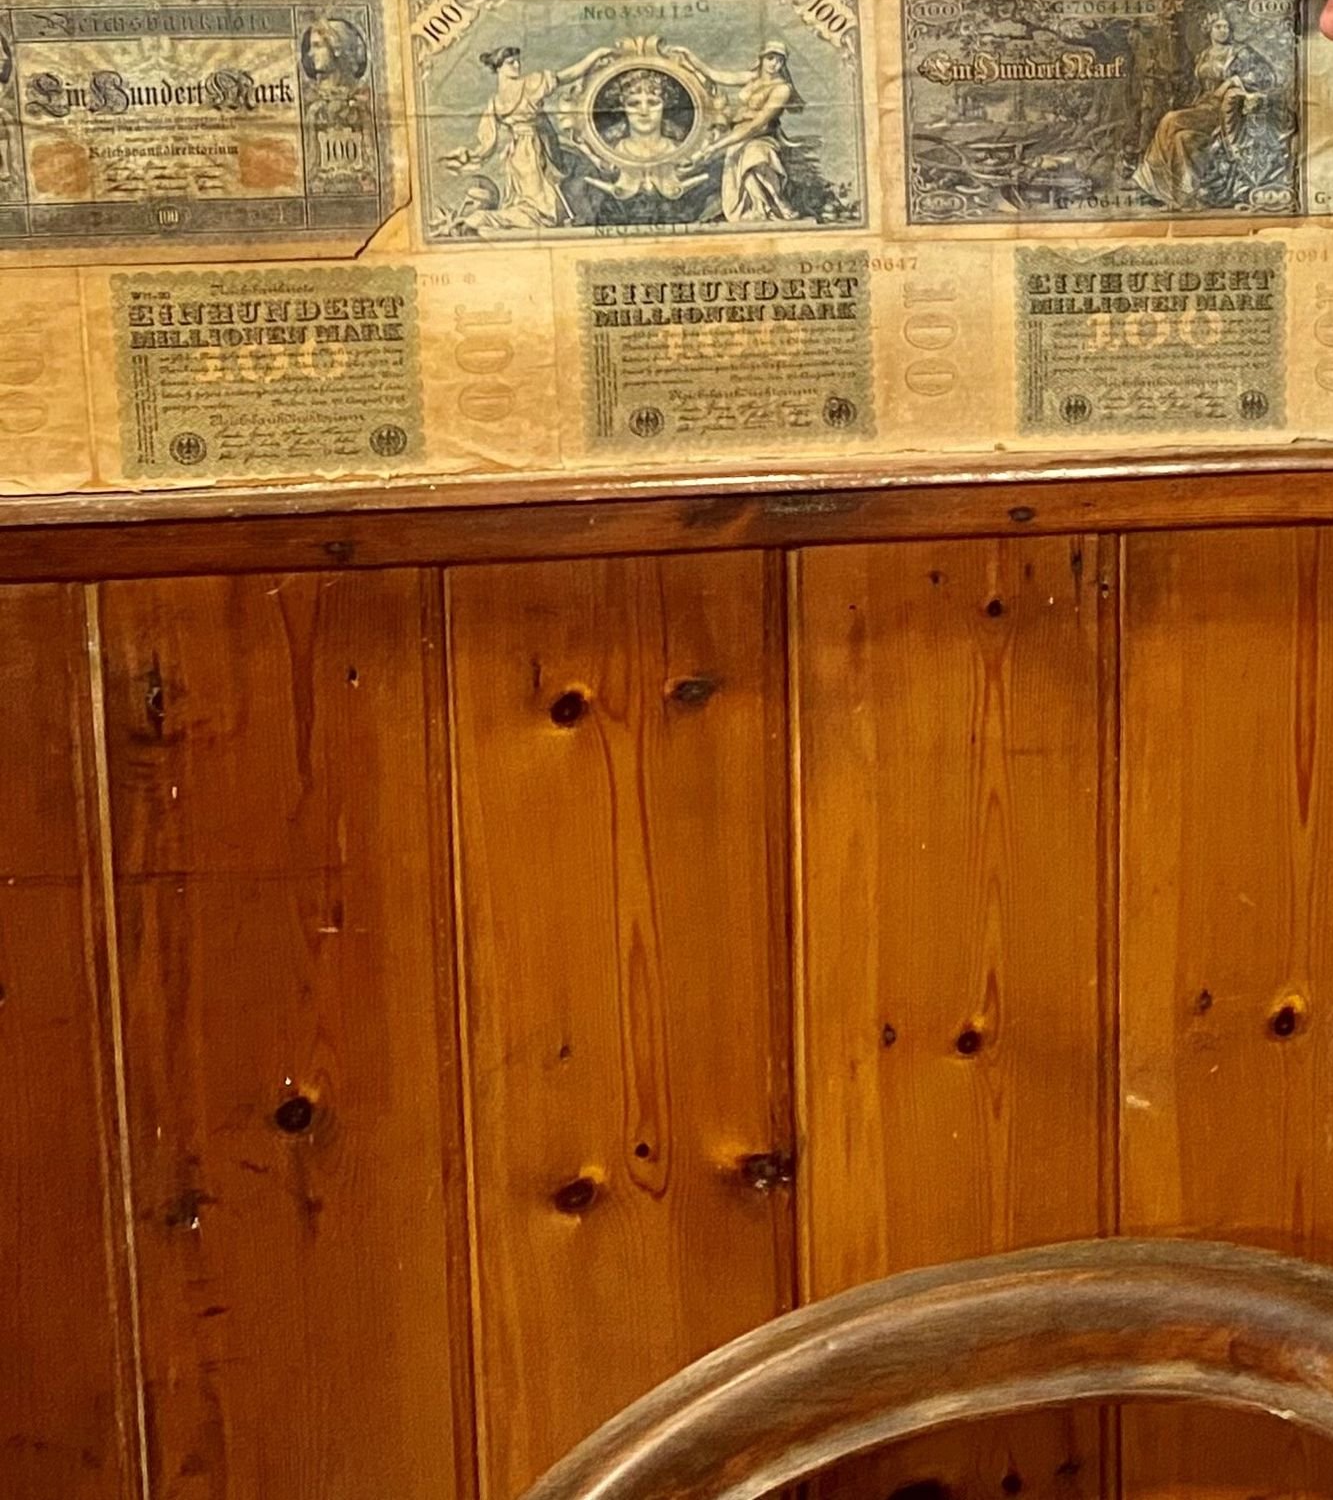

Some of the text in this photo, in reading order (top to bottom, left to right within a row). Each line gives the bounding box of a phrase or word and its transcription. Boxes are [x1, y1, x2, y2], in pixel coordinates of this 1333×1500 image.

[421, 0, 463, 43] 100
[974, 53, 1061, 83] Hundert
[90, 71, 202, 114] Hundert
[205, 69, 293, 112] Mark
[324, 140, 358, 162] 100
[593, 278, 858, 306] EINHUNDERT
[1028, 271, 1276, 294] EINHUNDERT
[129, 298, 404, 326] EINHUNDERT
[594, 300, 857, 327] MILLIONEN MARK
[1030, 292, 1274, 315] MILLIONEN MARK
[130, 324, 403, 349] MILLIONEN MARK
